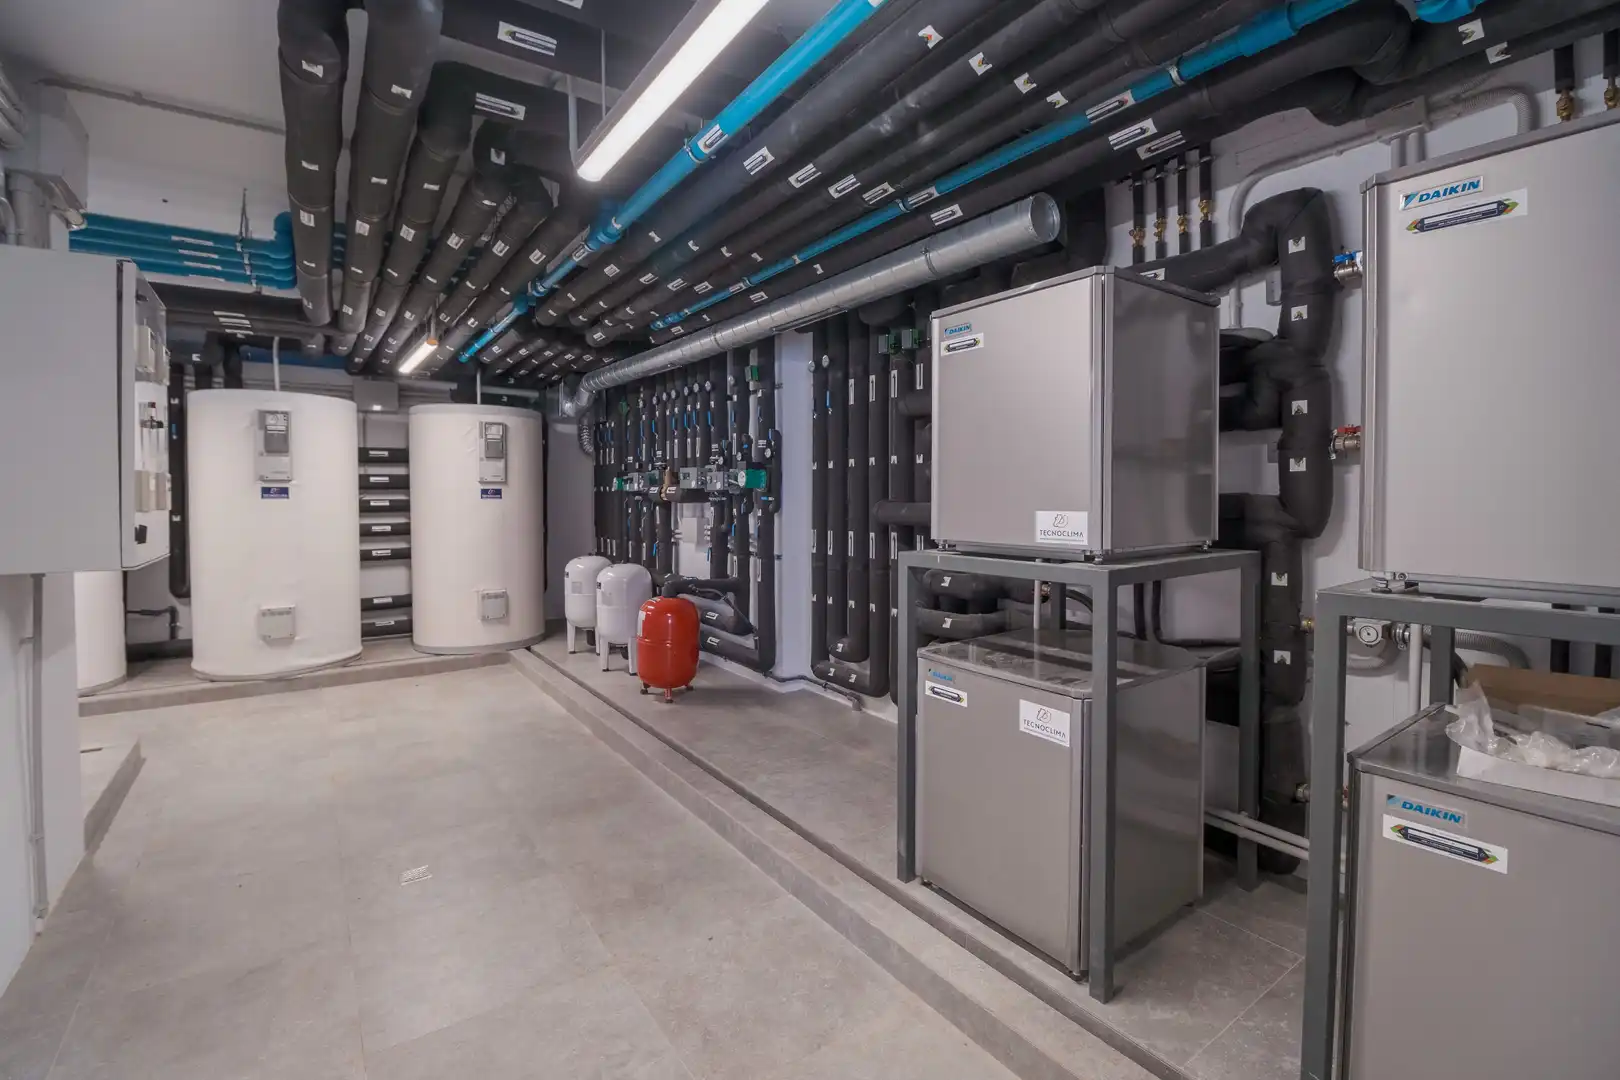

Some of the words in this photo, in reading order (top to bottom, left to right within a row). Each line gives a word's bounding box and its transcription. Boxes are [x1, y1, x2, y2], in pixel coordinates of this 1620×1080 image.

[1418, 179, 1481, 203] DAIKIN
[1039, 529, 1084, 538] TECNOCLIMA
[1023, 719, 1066, 738] TECNOCLIMA
[1401, 801, 1462, 824] DAIKIN
